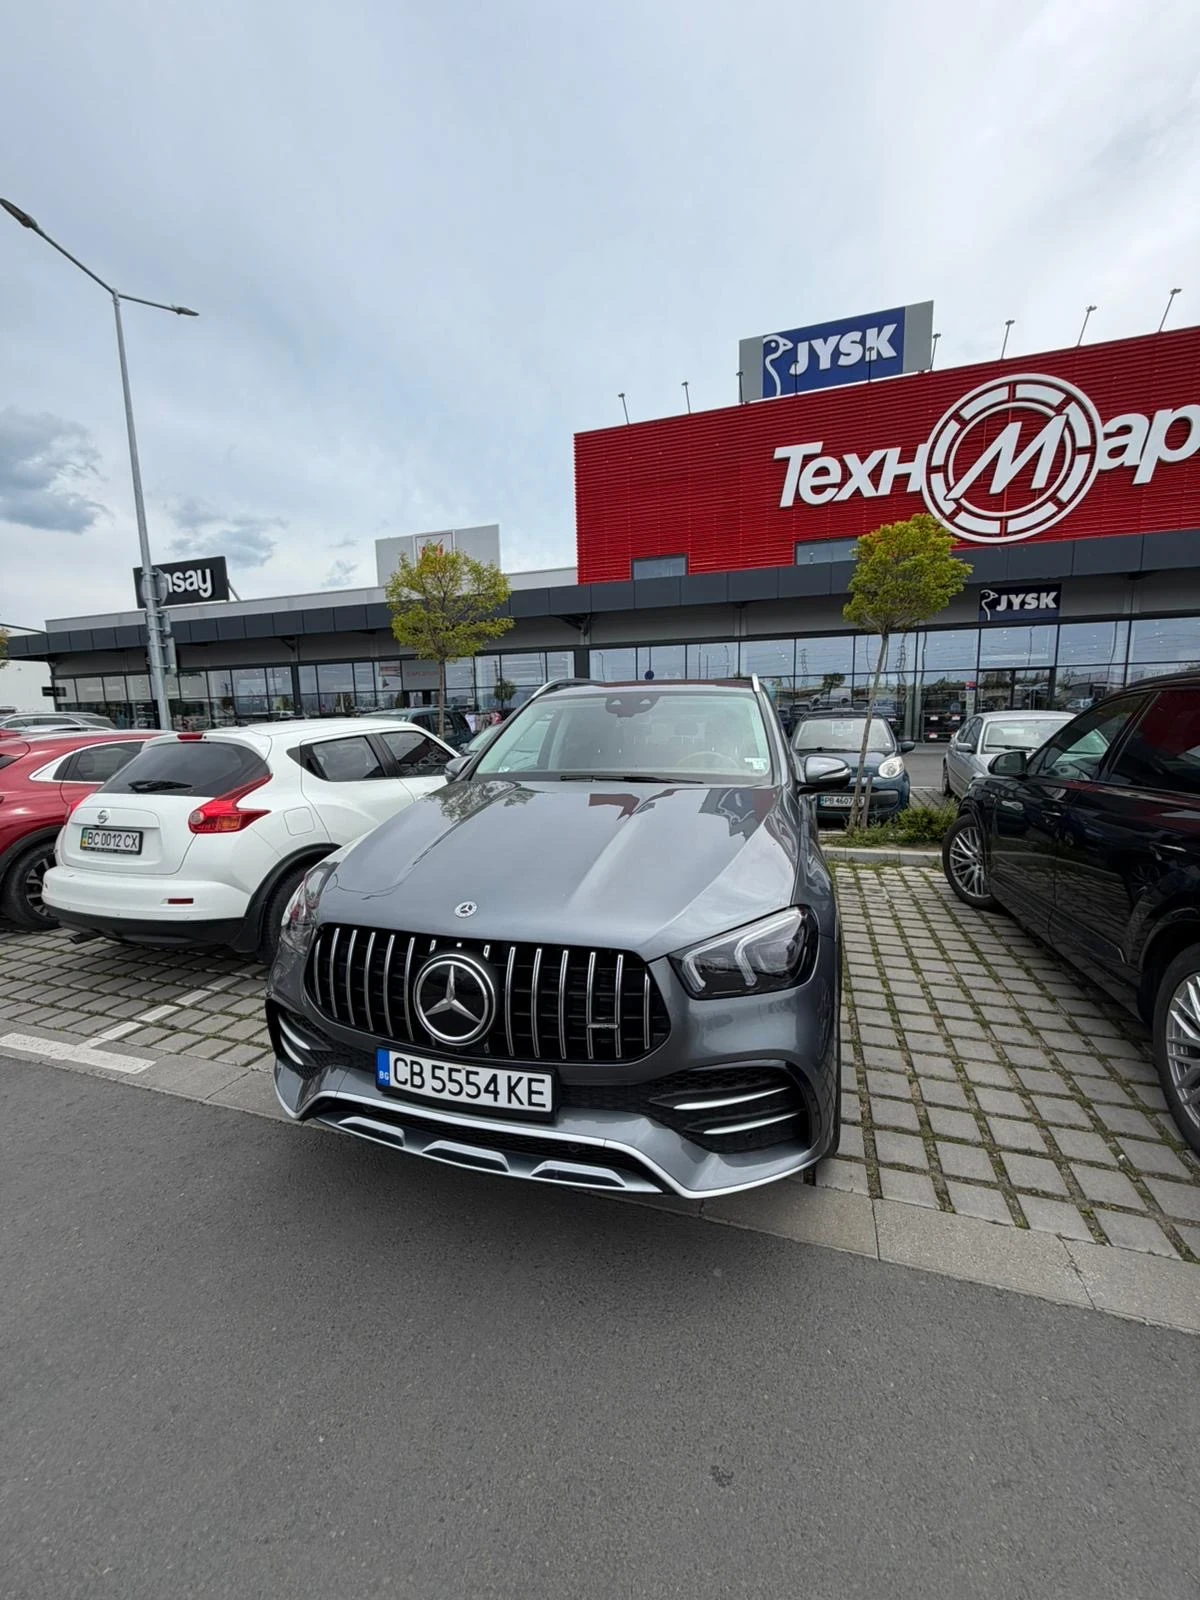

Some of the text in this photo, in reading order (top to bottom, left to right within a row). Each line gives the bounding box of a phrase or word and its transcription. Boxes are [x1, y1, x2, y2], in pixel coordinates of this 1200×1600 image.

[789, 323, 898, 376] JYSK
[995, 591, 1058, 612] JYSK
[393, 1057, 547, 1109] CB 5554 KE
